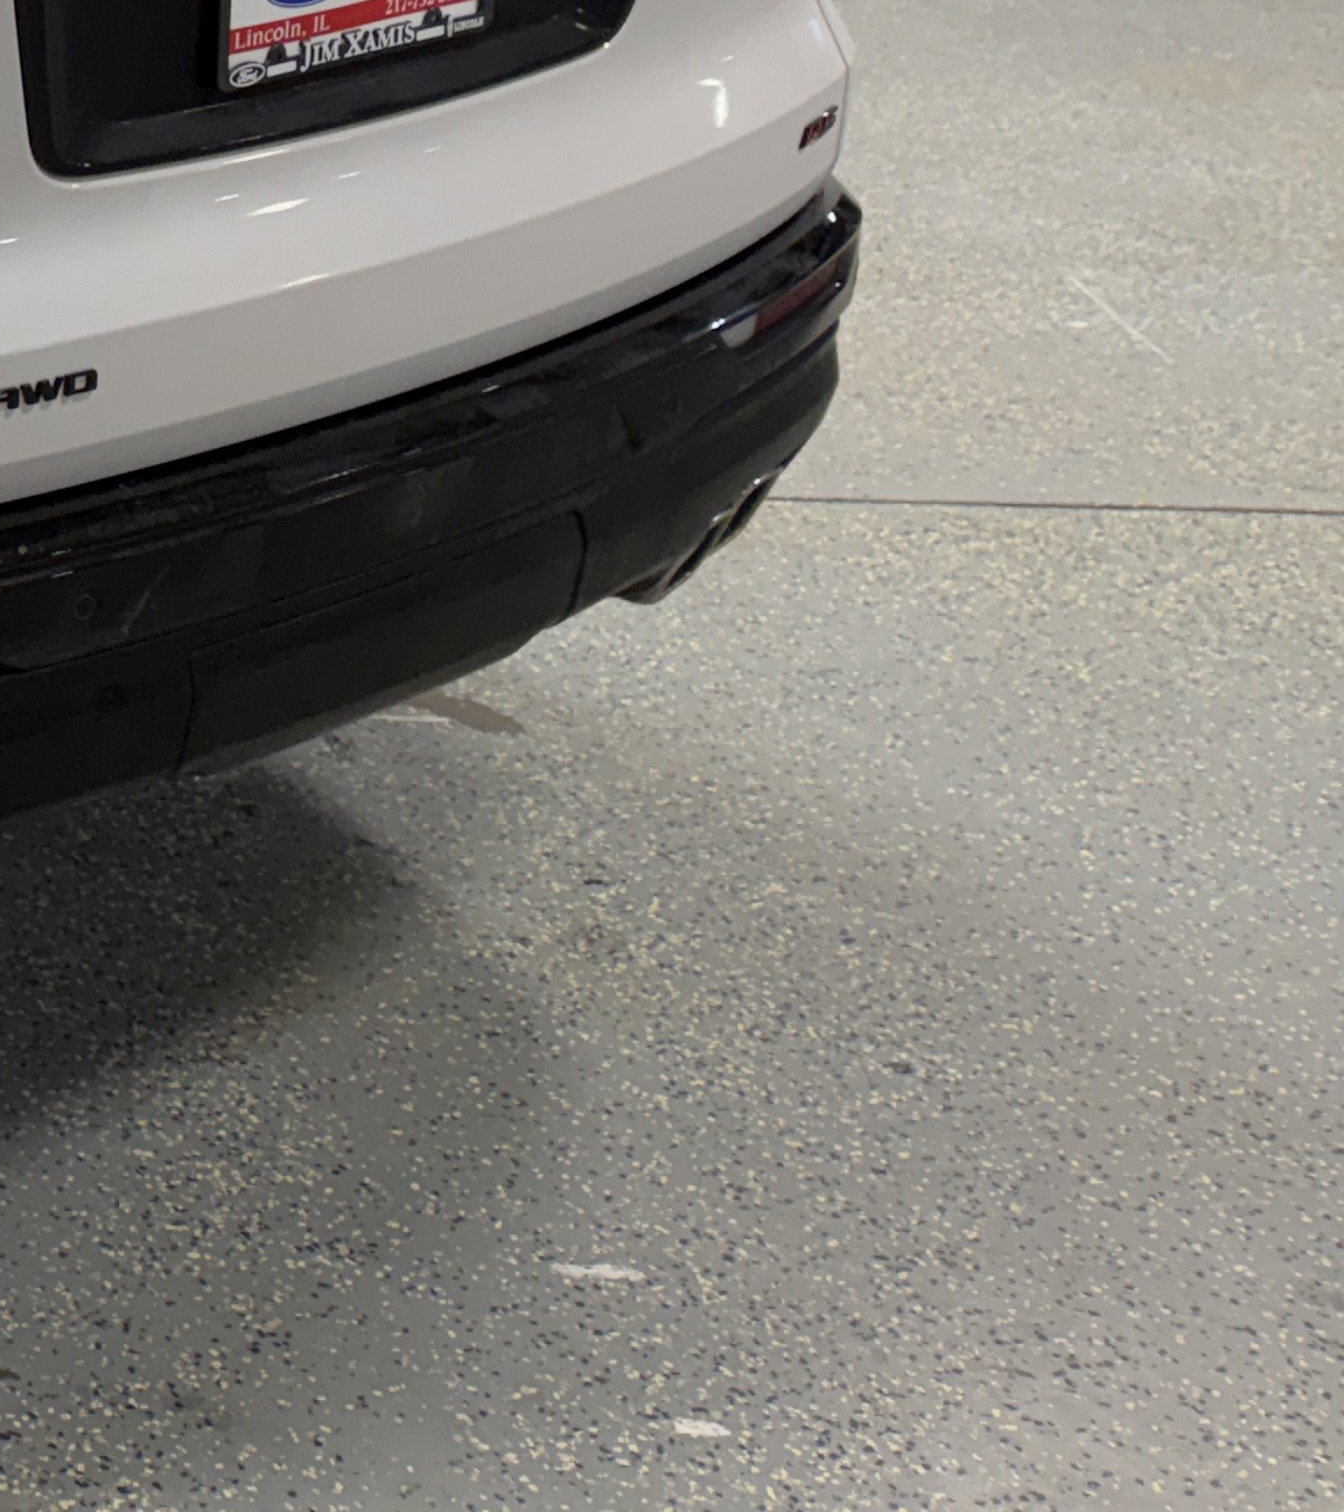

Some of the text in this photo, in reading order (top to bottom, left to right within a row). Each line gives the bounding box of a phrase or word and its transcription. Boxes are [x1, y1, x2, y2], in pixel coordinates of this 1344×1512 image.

[234, 14, 331, 50] Lincoln, IL
[300, 40, 343, 73] JIM
[343, 23, 416, 60] XAMIS
